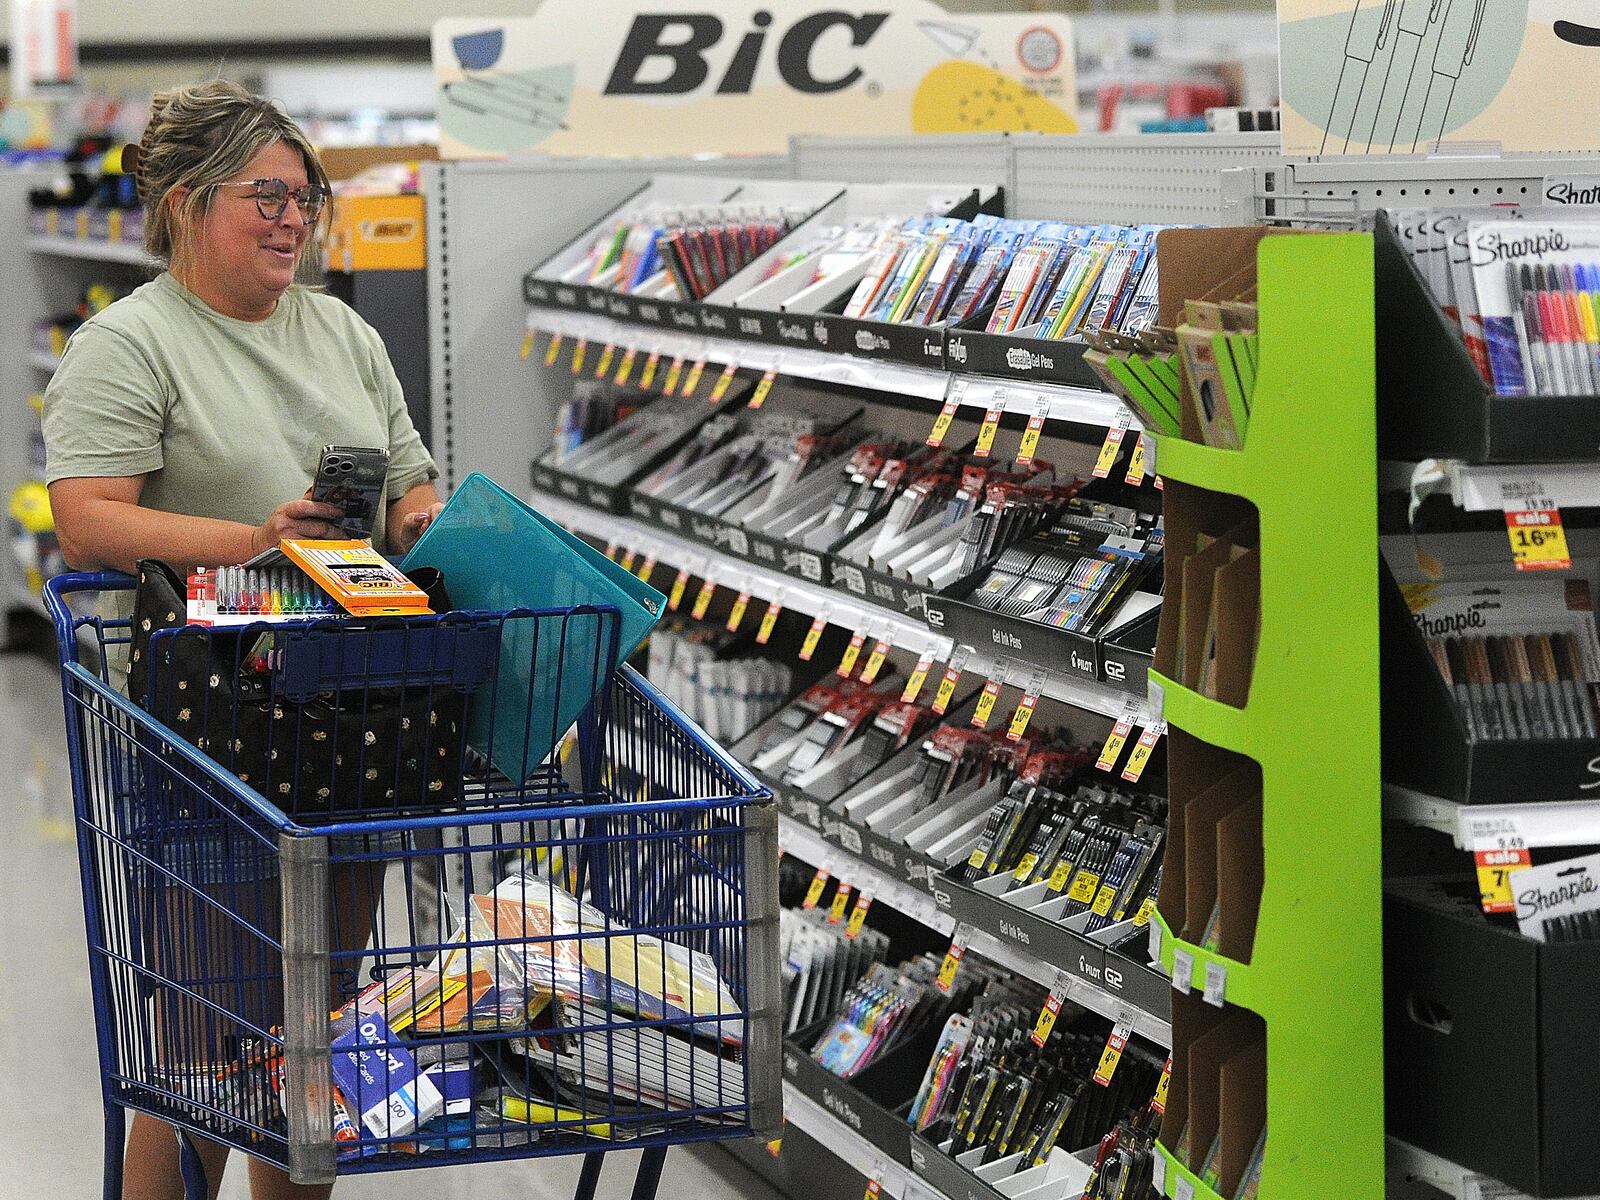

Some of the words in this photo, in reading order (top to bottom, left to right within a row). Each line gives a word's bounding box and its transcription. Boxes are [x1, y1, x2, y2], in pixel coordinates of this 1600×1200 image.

[1472, 228, 1570, 266] Sharpie
[1031, 353, 1040, 367] Gel
[1041, 354, 1054, 369] Pens
[992, 628, 1000, 643] Gel
[1001, 631, 1009, 646] Ink
[1009, 633, 1022, 650] Pens
[1077, 658, 1092, 673] PILOT
[1104, 660, 1126, 679] G2
[1518, 875, 1599, 921] Sharpie
[1000, 919, 1008, 935] Gel
[1009, 923, 1017, 938] Ink
[1017, 927, 1030, 944] Pens
[1085, 964, 1101, 979] PILOT
[1105, 968, 1123, 989] G2
[389, 1100, 406, 1118] 100
